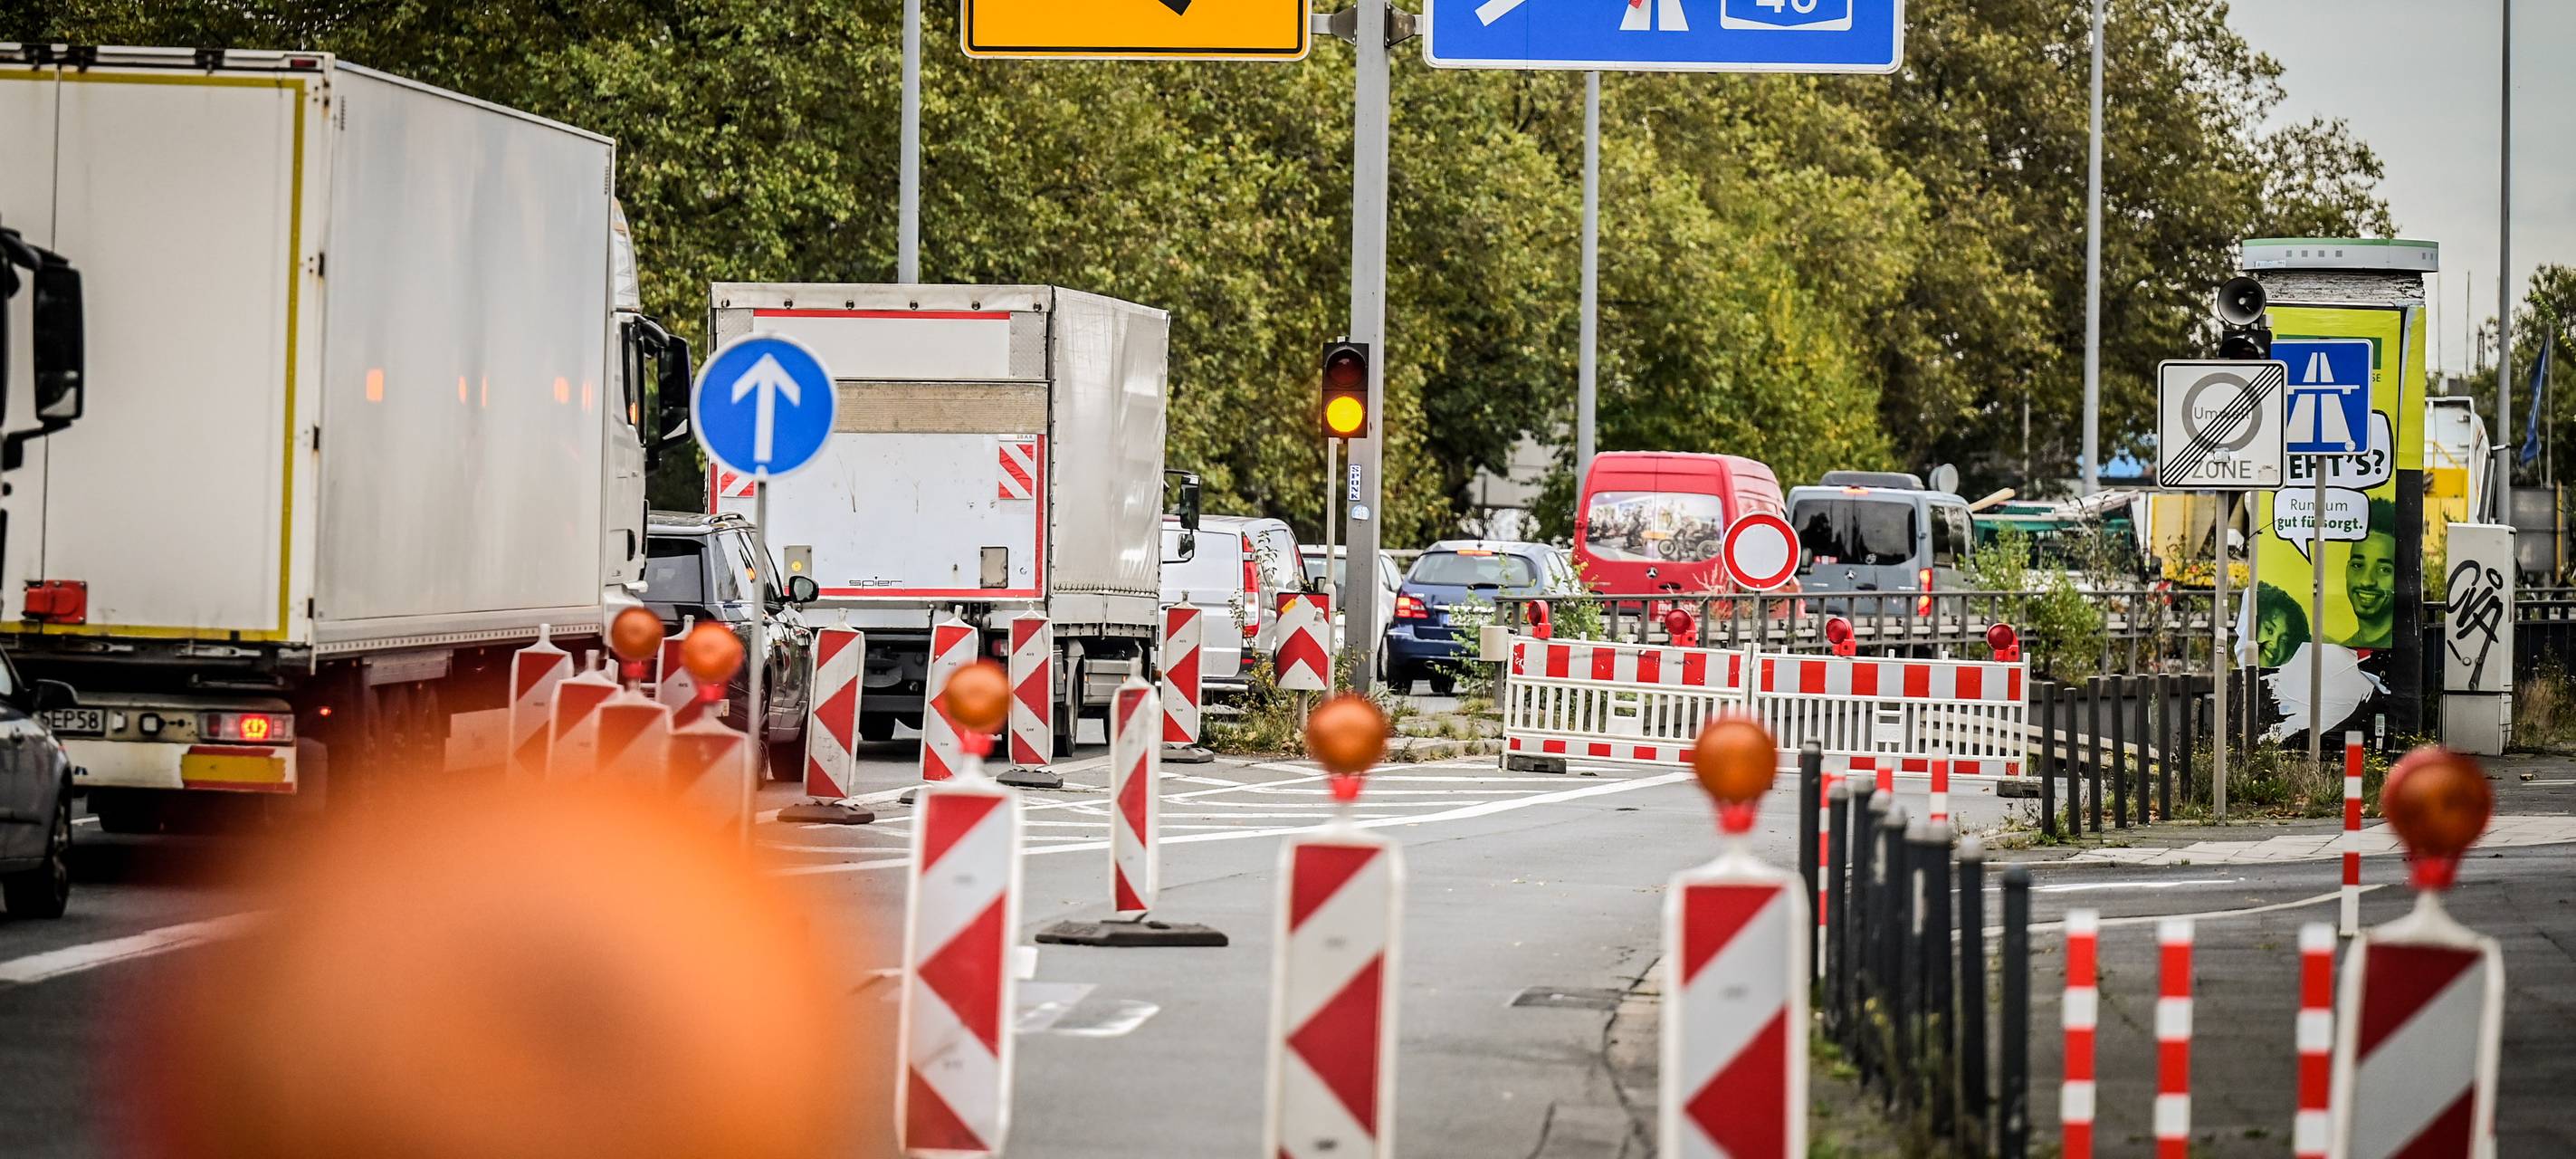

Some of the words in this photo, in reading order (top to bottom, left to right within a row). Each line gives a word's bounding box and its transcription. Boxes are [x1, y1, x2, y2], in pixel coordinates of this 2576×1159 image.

[2191, 460, 2252, 479] ZONE
[2289, 449, 2384, 479] EHT’S?
[2290, 498, 2348, 512] Runum
[2277, 515, 2297, 532] gut
[2301, 515, 2363, 532] füorgt.
[849, 576, 903, 589] spier
